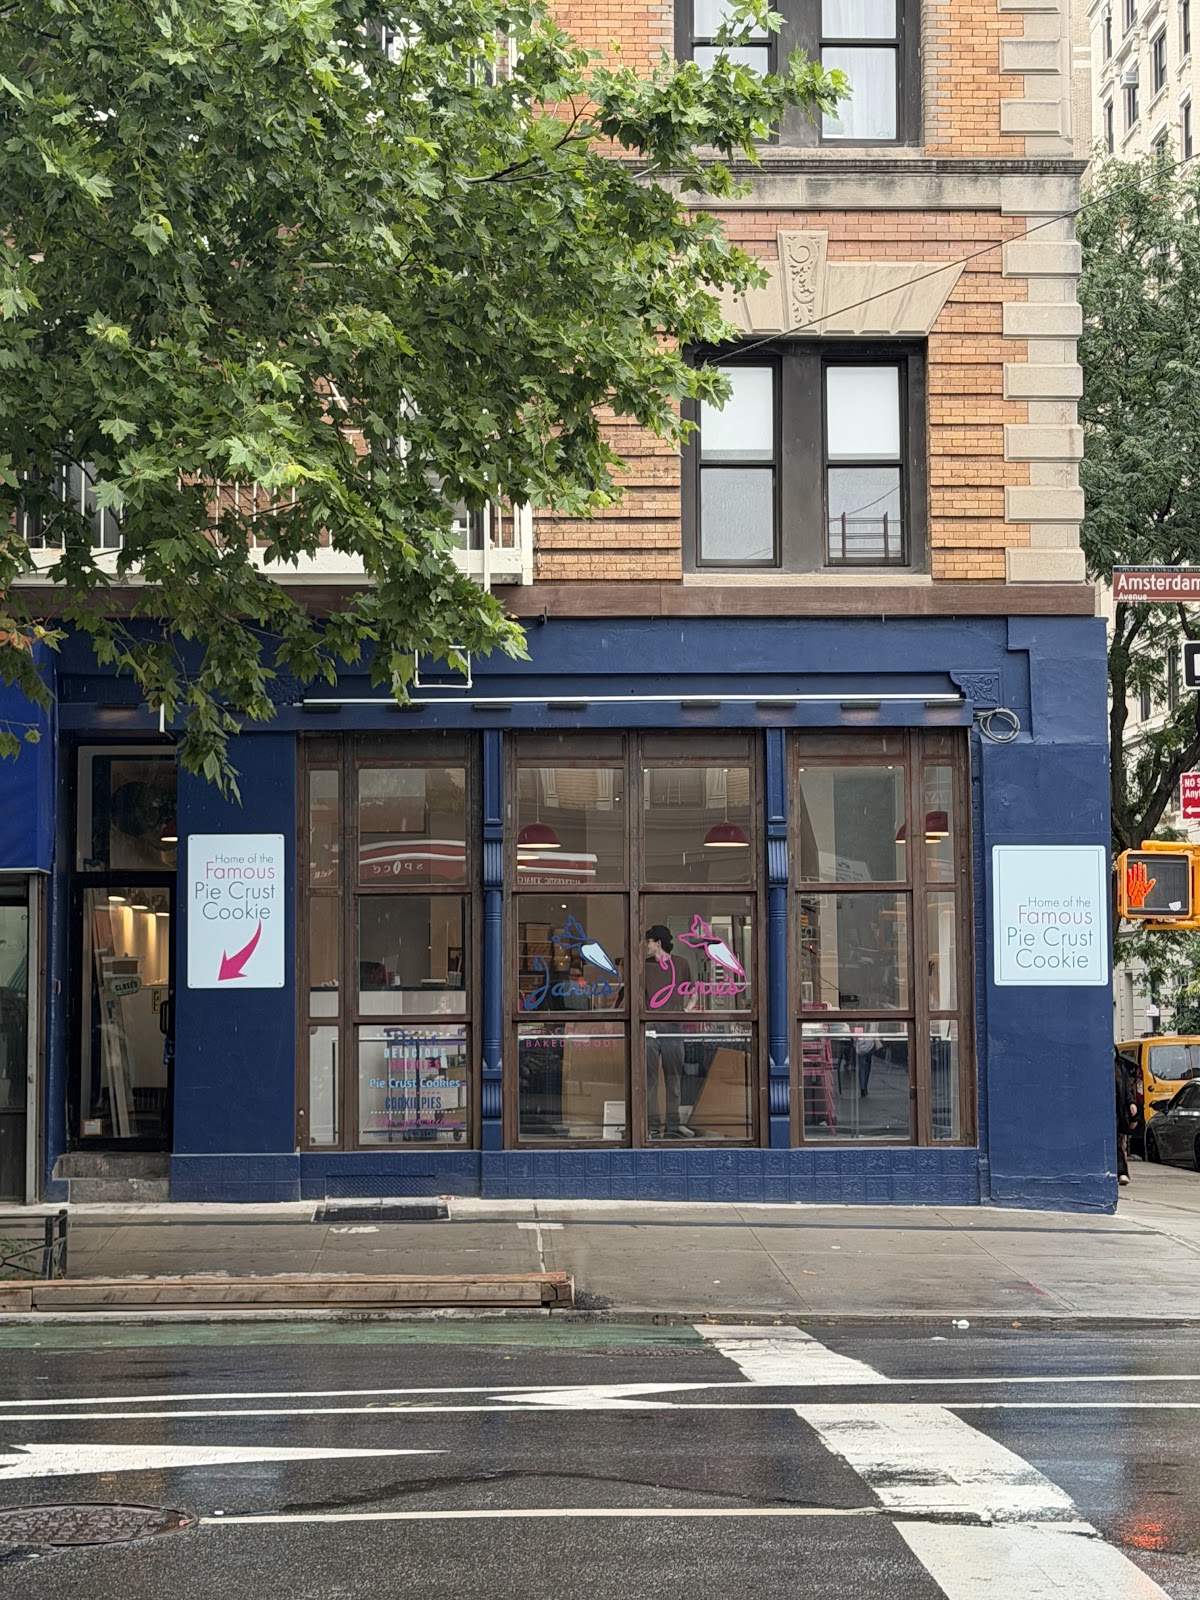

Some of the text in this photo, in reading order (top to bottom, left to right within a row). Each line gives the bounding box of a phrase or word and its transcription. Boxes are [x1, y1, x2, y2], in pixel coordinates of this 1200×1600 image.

[1118, 592, 1148, 601] Avenue
[1184, 778, 1196, 788] NO
[215, 852, 274, 863] Home of the
[205, 861, 275, 879] Famous
[195, 881, 275, 900] Pie Crust
[1028, 896, 1091, 907] Home of the
[202, 900, 271, 920] Cookie
[1018, 905, 1093, 924] Famous
[1007, 926, 1093, 946] Pie Crust
[1015, 947, 1089, 968] Cookie
[115, 981, 138, 991] CLOSED
[524, 956, 618, 1009] Janie's
[650, 954, 740, 1009] Janie's
[525, 1039, 566, 1048] BAKED
[384, 1048, 447, 1059] DELICIOUS
[369, 1078, 460, 1088] Pie Crust Cookies
[421, 1097, 442, 1109] PIES
